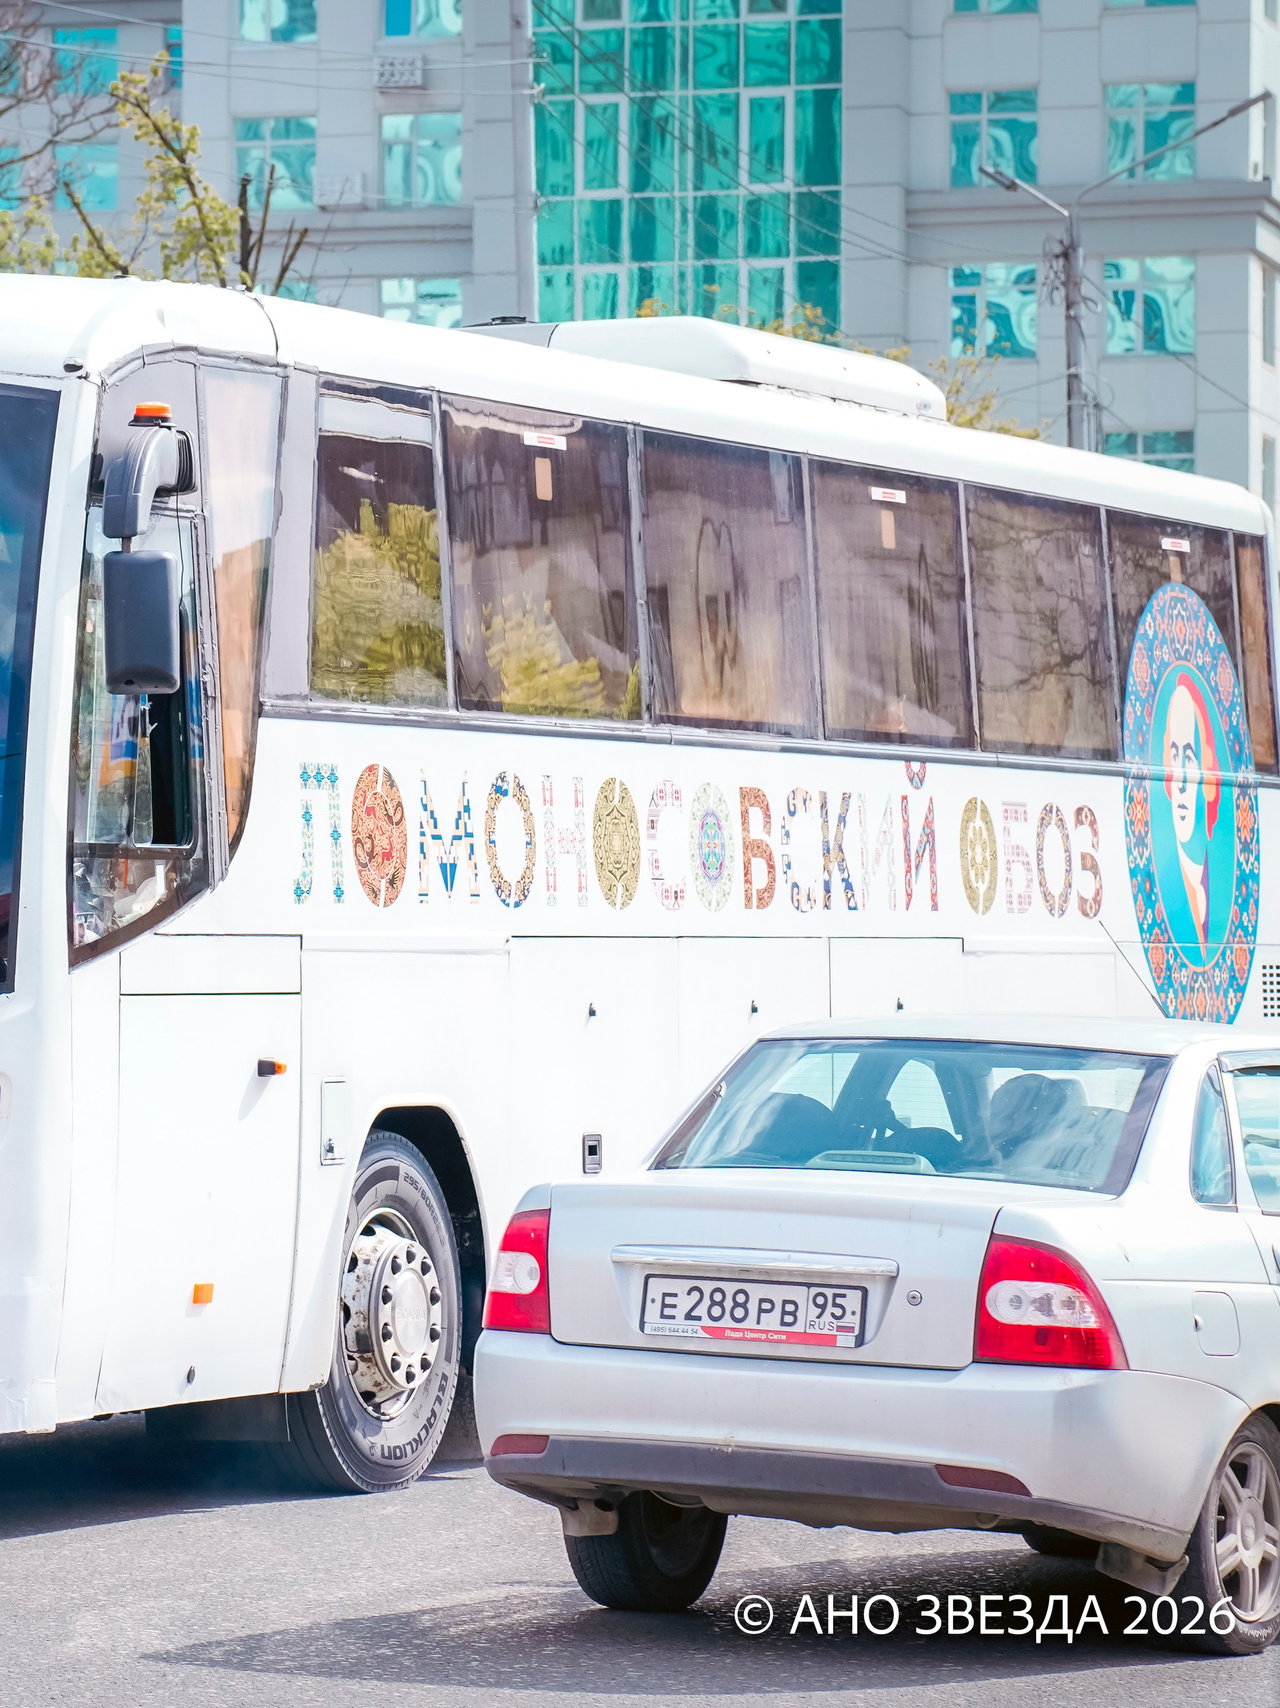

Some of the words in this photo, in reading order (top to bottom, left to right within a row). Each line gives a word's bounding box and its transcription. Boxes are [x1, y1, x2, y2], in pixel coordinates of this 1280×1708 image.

[293, 761, 938, 914] ЛОМОНОСОВСКИЙ
[959, 797, 1102, 919] ОБОЗ
[659, 1286, 799, 1327] Е288РВ
[812, 1292, 847, 1320] 95
[724, 1329, 744, 1338] Лада
[744, 1331, 767, 1341] Центр
[809, 1320, 835, 1331] RUS
